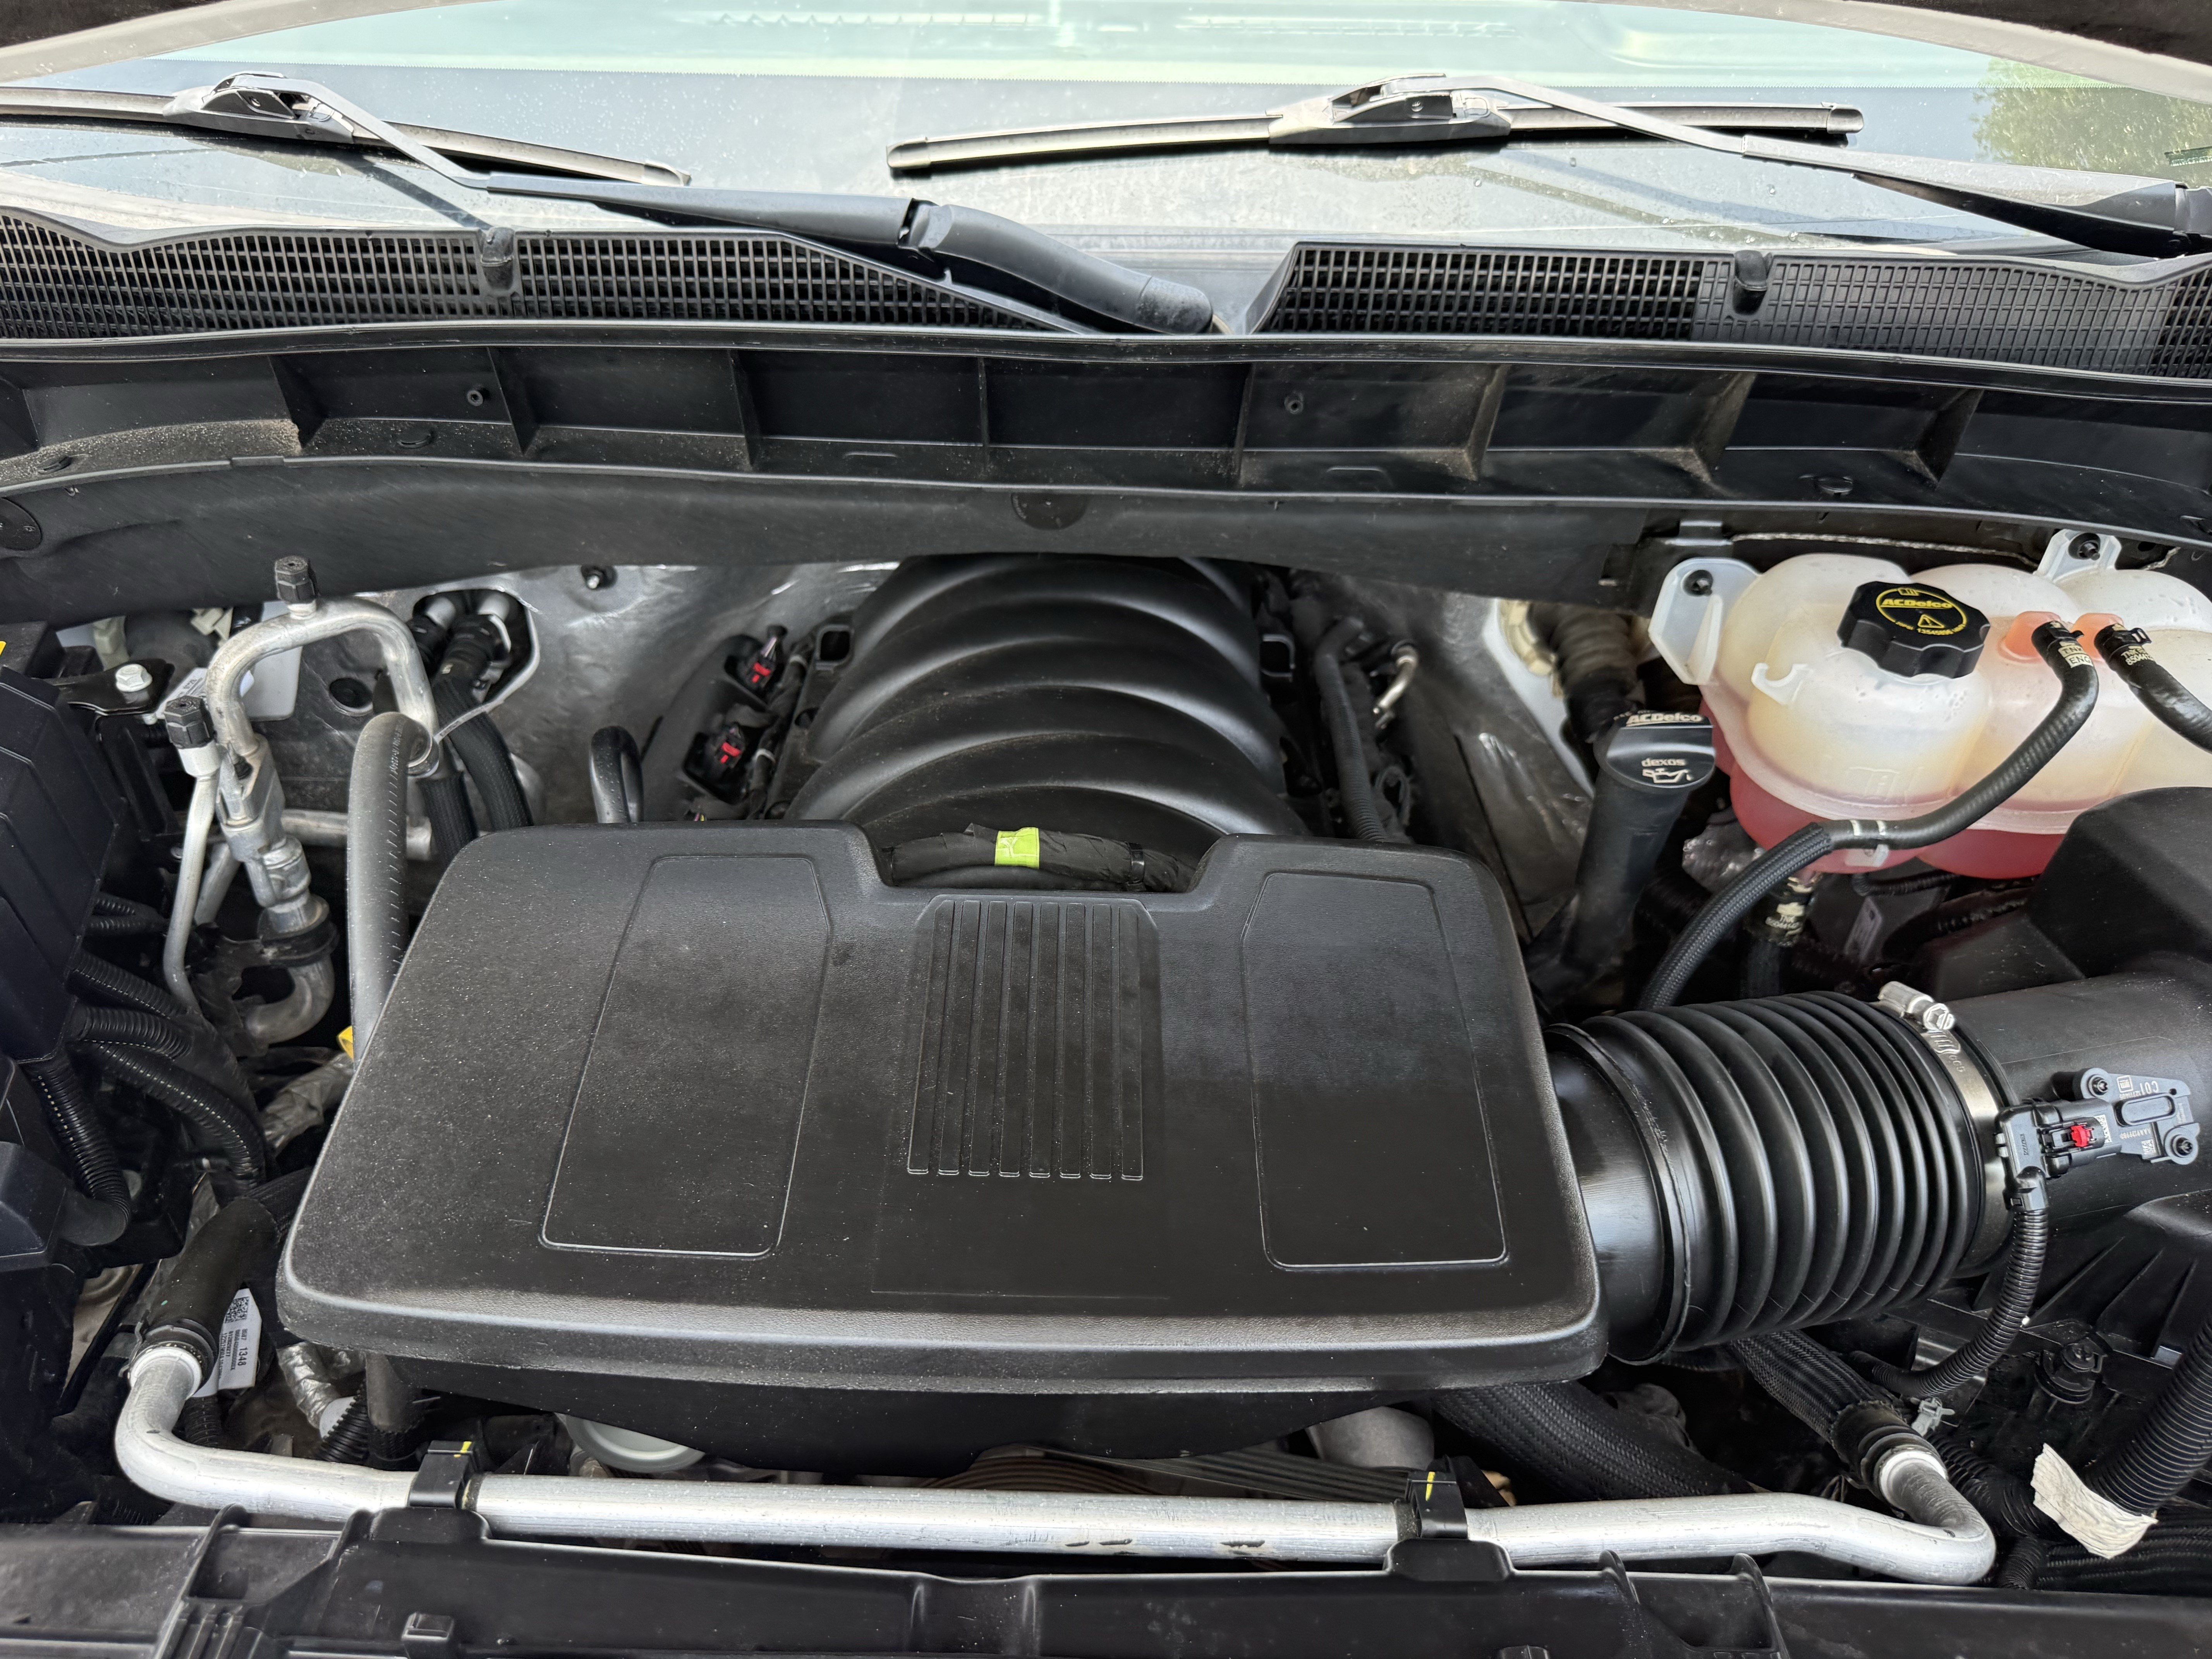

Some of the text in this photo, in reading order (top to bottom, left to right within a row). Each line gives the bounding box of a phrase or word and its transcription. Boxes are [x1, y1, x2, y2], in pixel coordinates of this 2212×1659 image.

[1882, 598, 1953, 608] ACDelco
[2071, 656, 2091, 664] ENG
[1626, 713, 1702, 725] ACDelco
[1642, 758, 1686, 767] dexos
[238, 1347, 248, 1366] 1348
